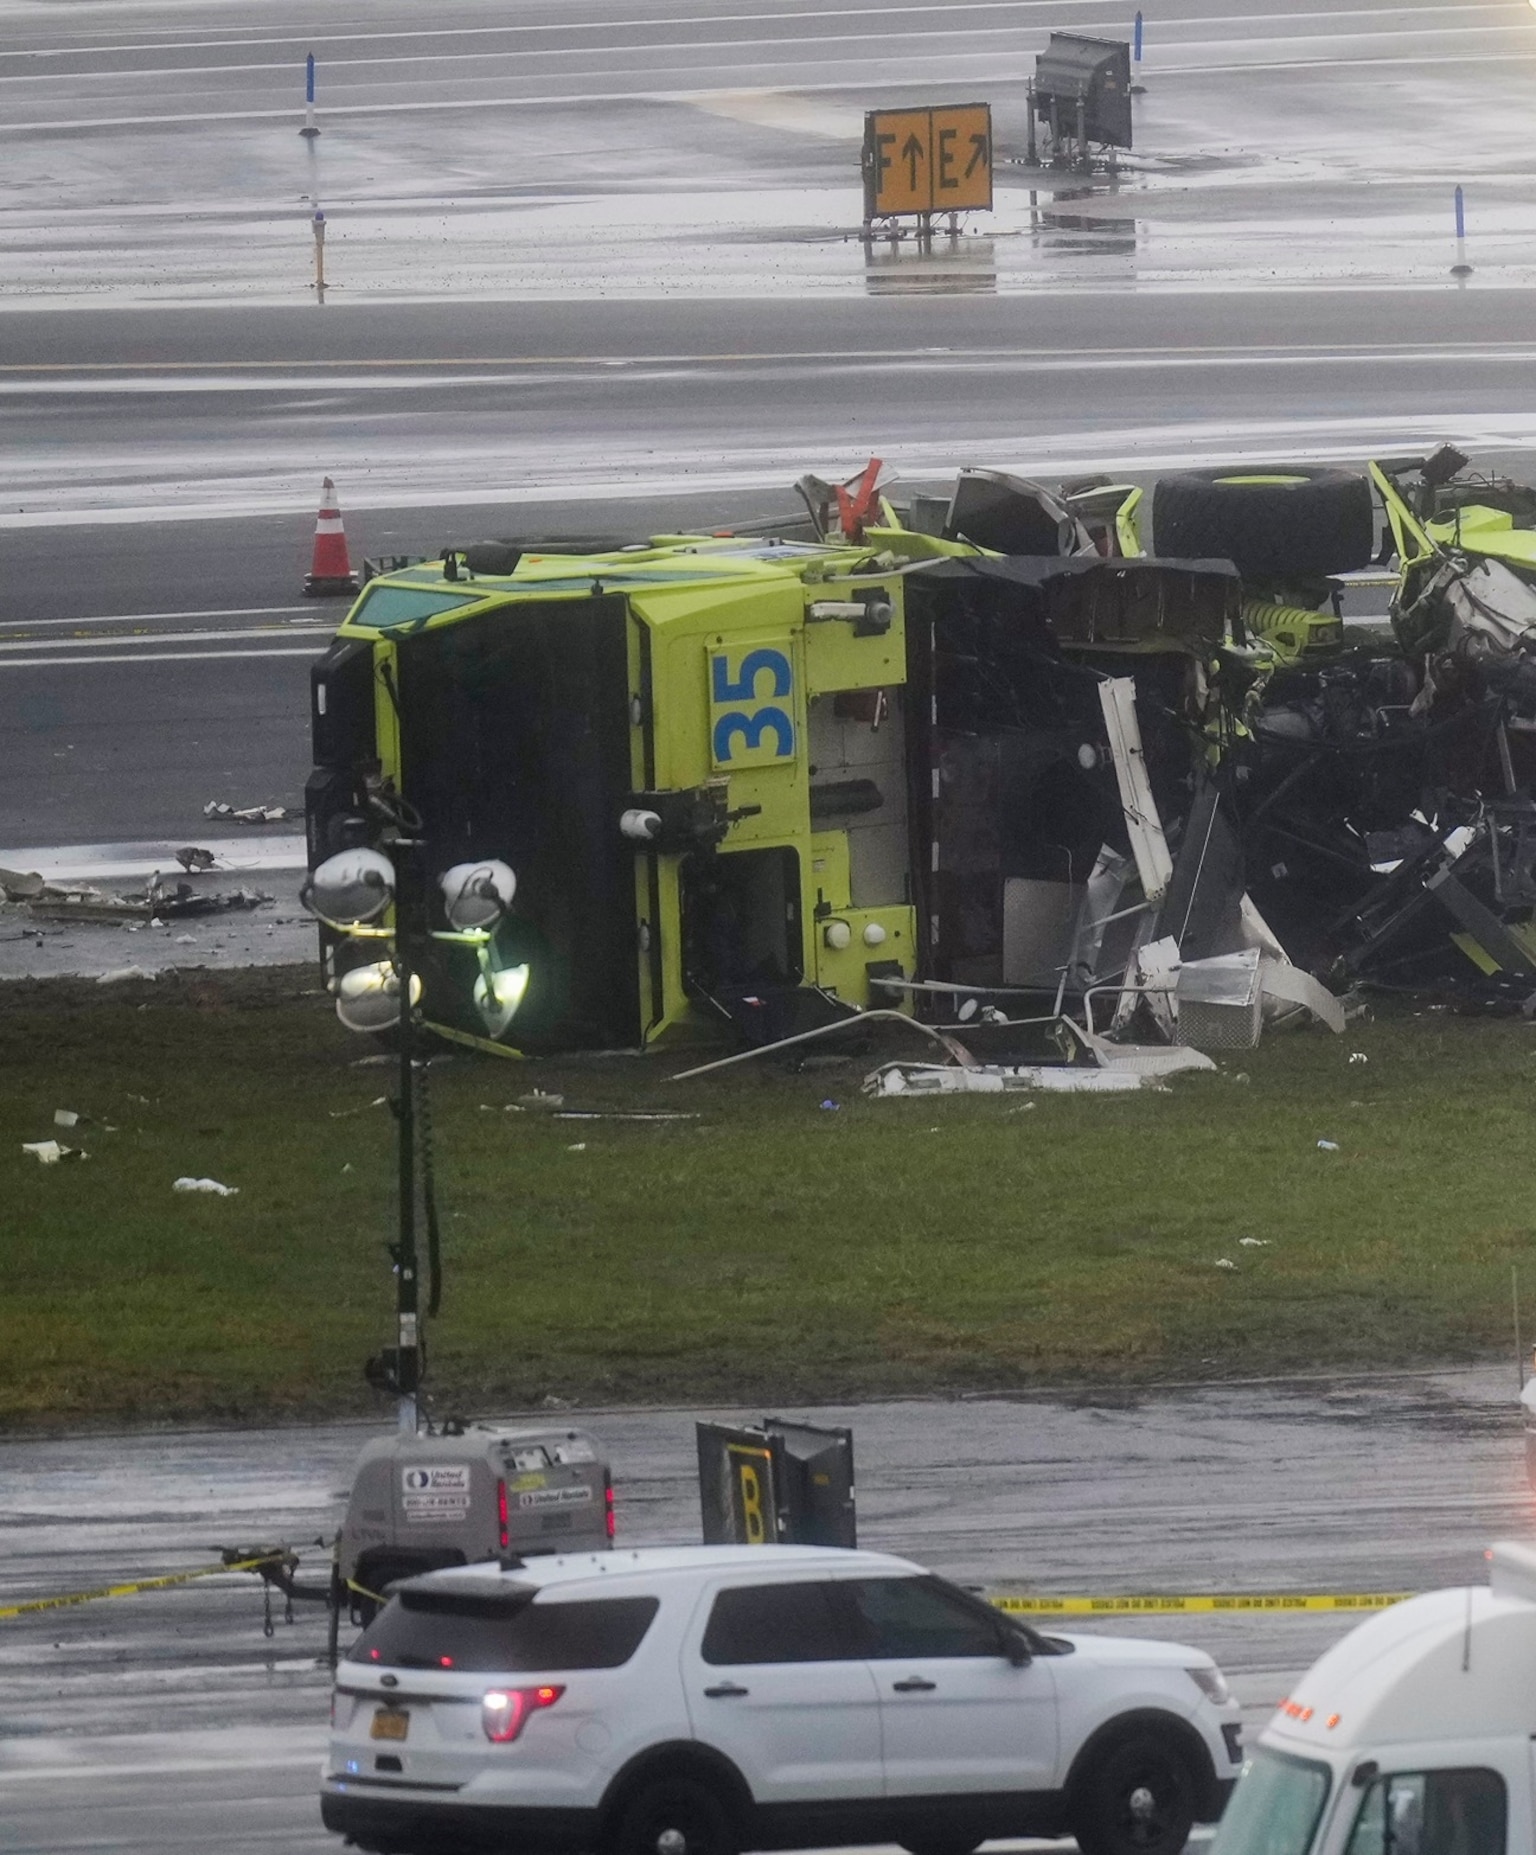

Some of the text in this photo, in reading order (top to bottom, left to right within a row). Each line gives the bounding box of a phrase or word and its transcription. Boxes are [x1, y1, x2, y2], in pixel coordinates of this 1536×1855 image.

[876, 129, 959, 194] F E
[712, 648, 794, 763] 35
[740, 1465, 764, 1545] B
